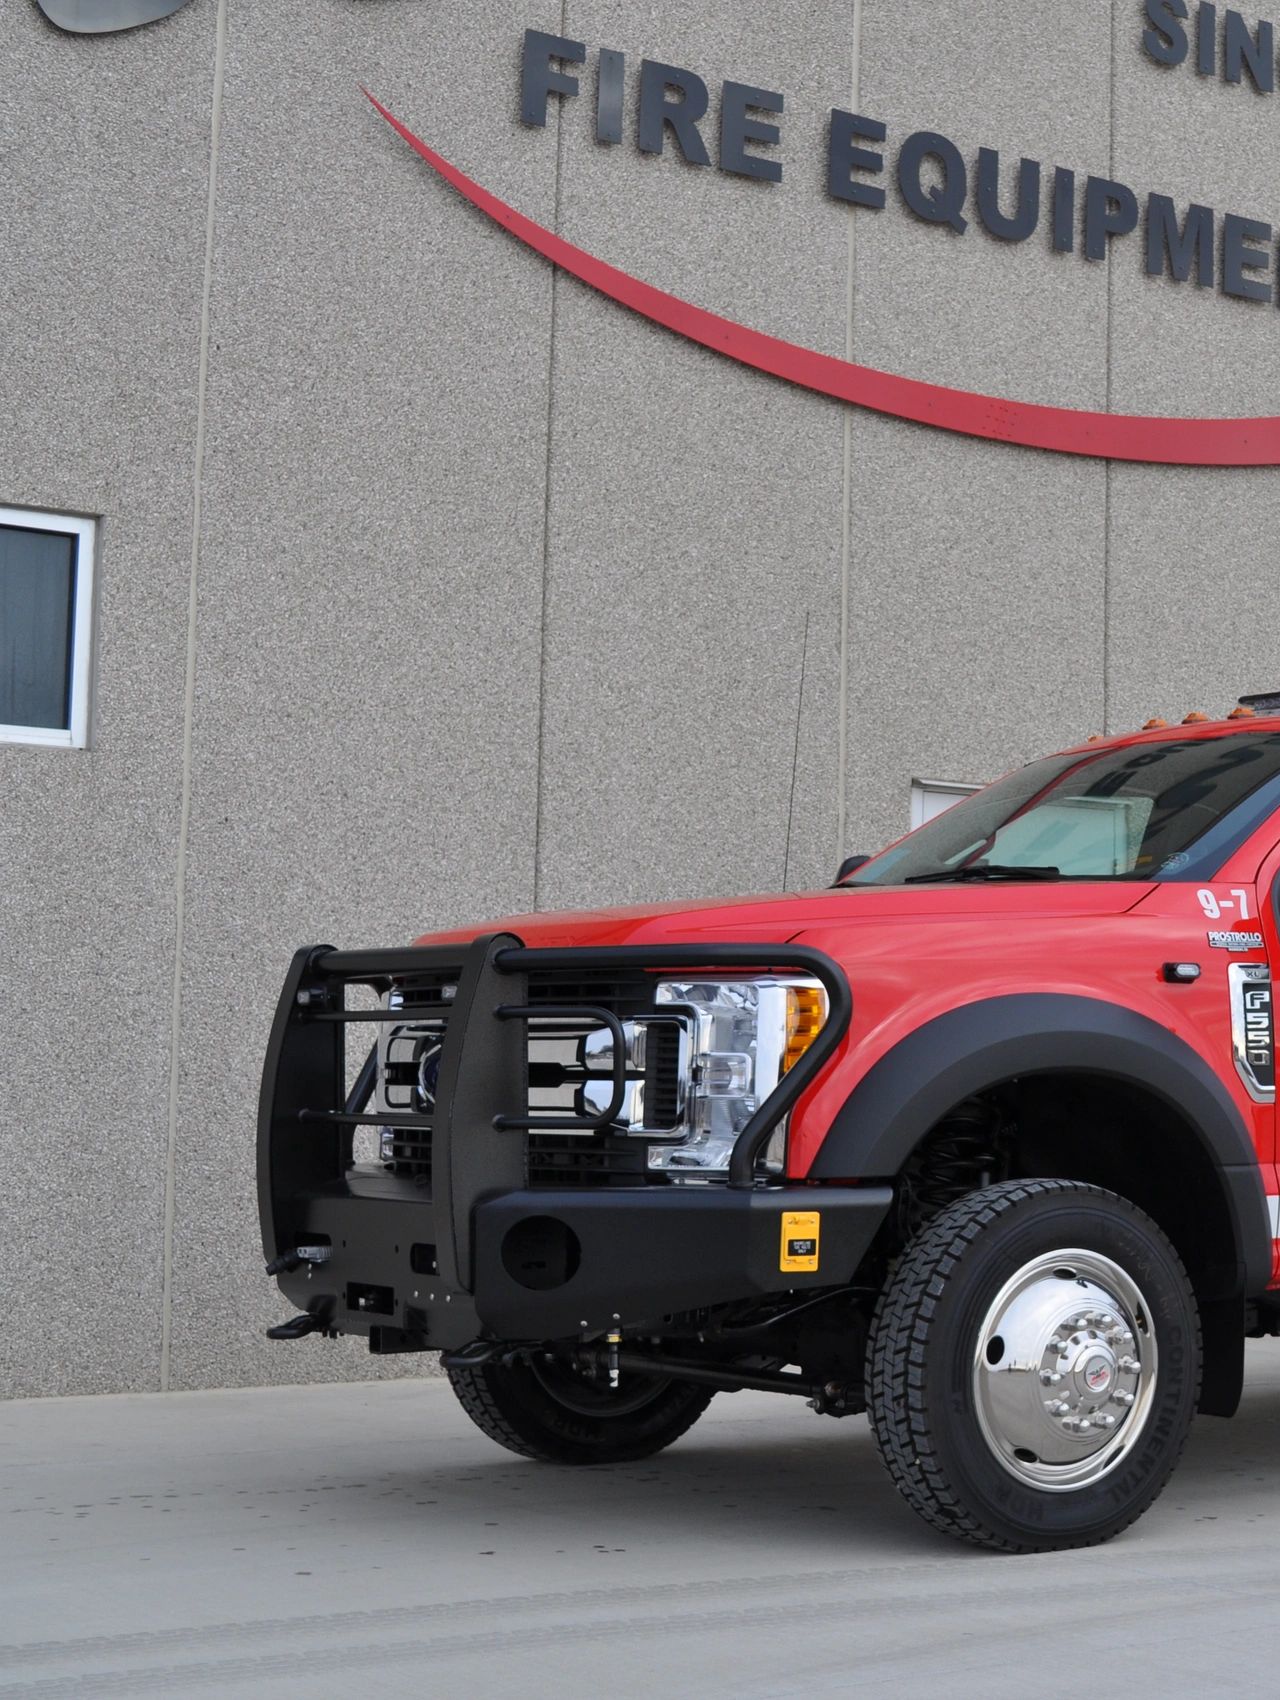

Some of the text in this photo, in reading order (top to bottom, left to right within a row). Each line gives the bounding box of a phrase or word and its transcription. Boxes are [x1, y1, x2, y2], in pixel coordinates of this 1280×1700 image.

[520, 28, 784, 184] FIRE
[1196, 889, 1249, 919] 9-7
[1208, 931, 1262, 942] PROSTROLLO
[1246, 970, 1260, 978] XL
[1106, 1325, 1183, 1503] CONTINENTAL
